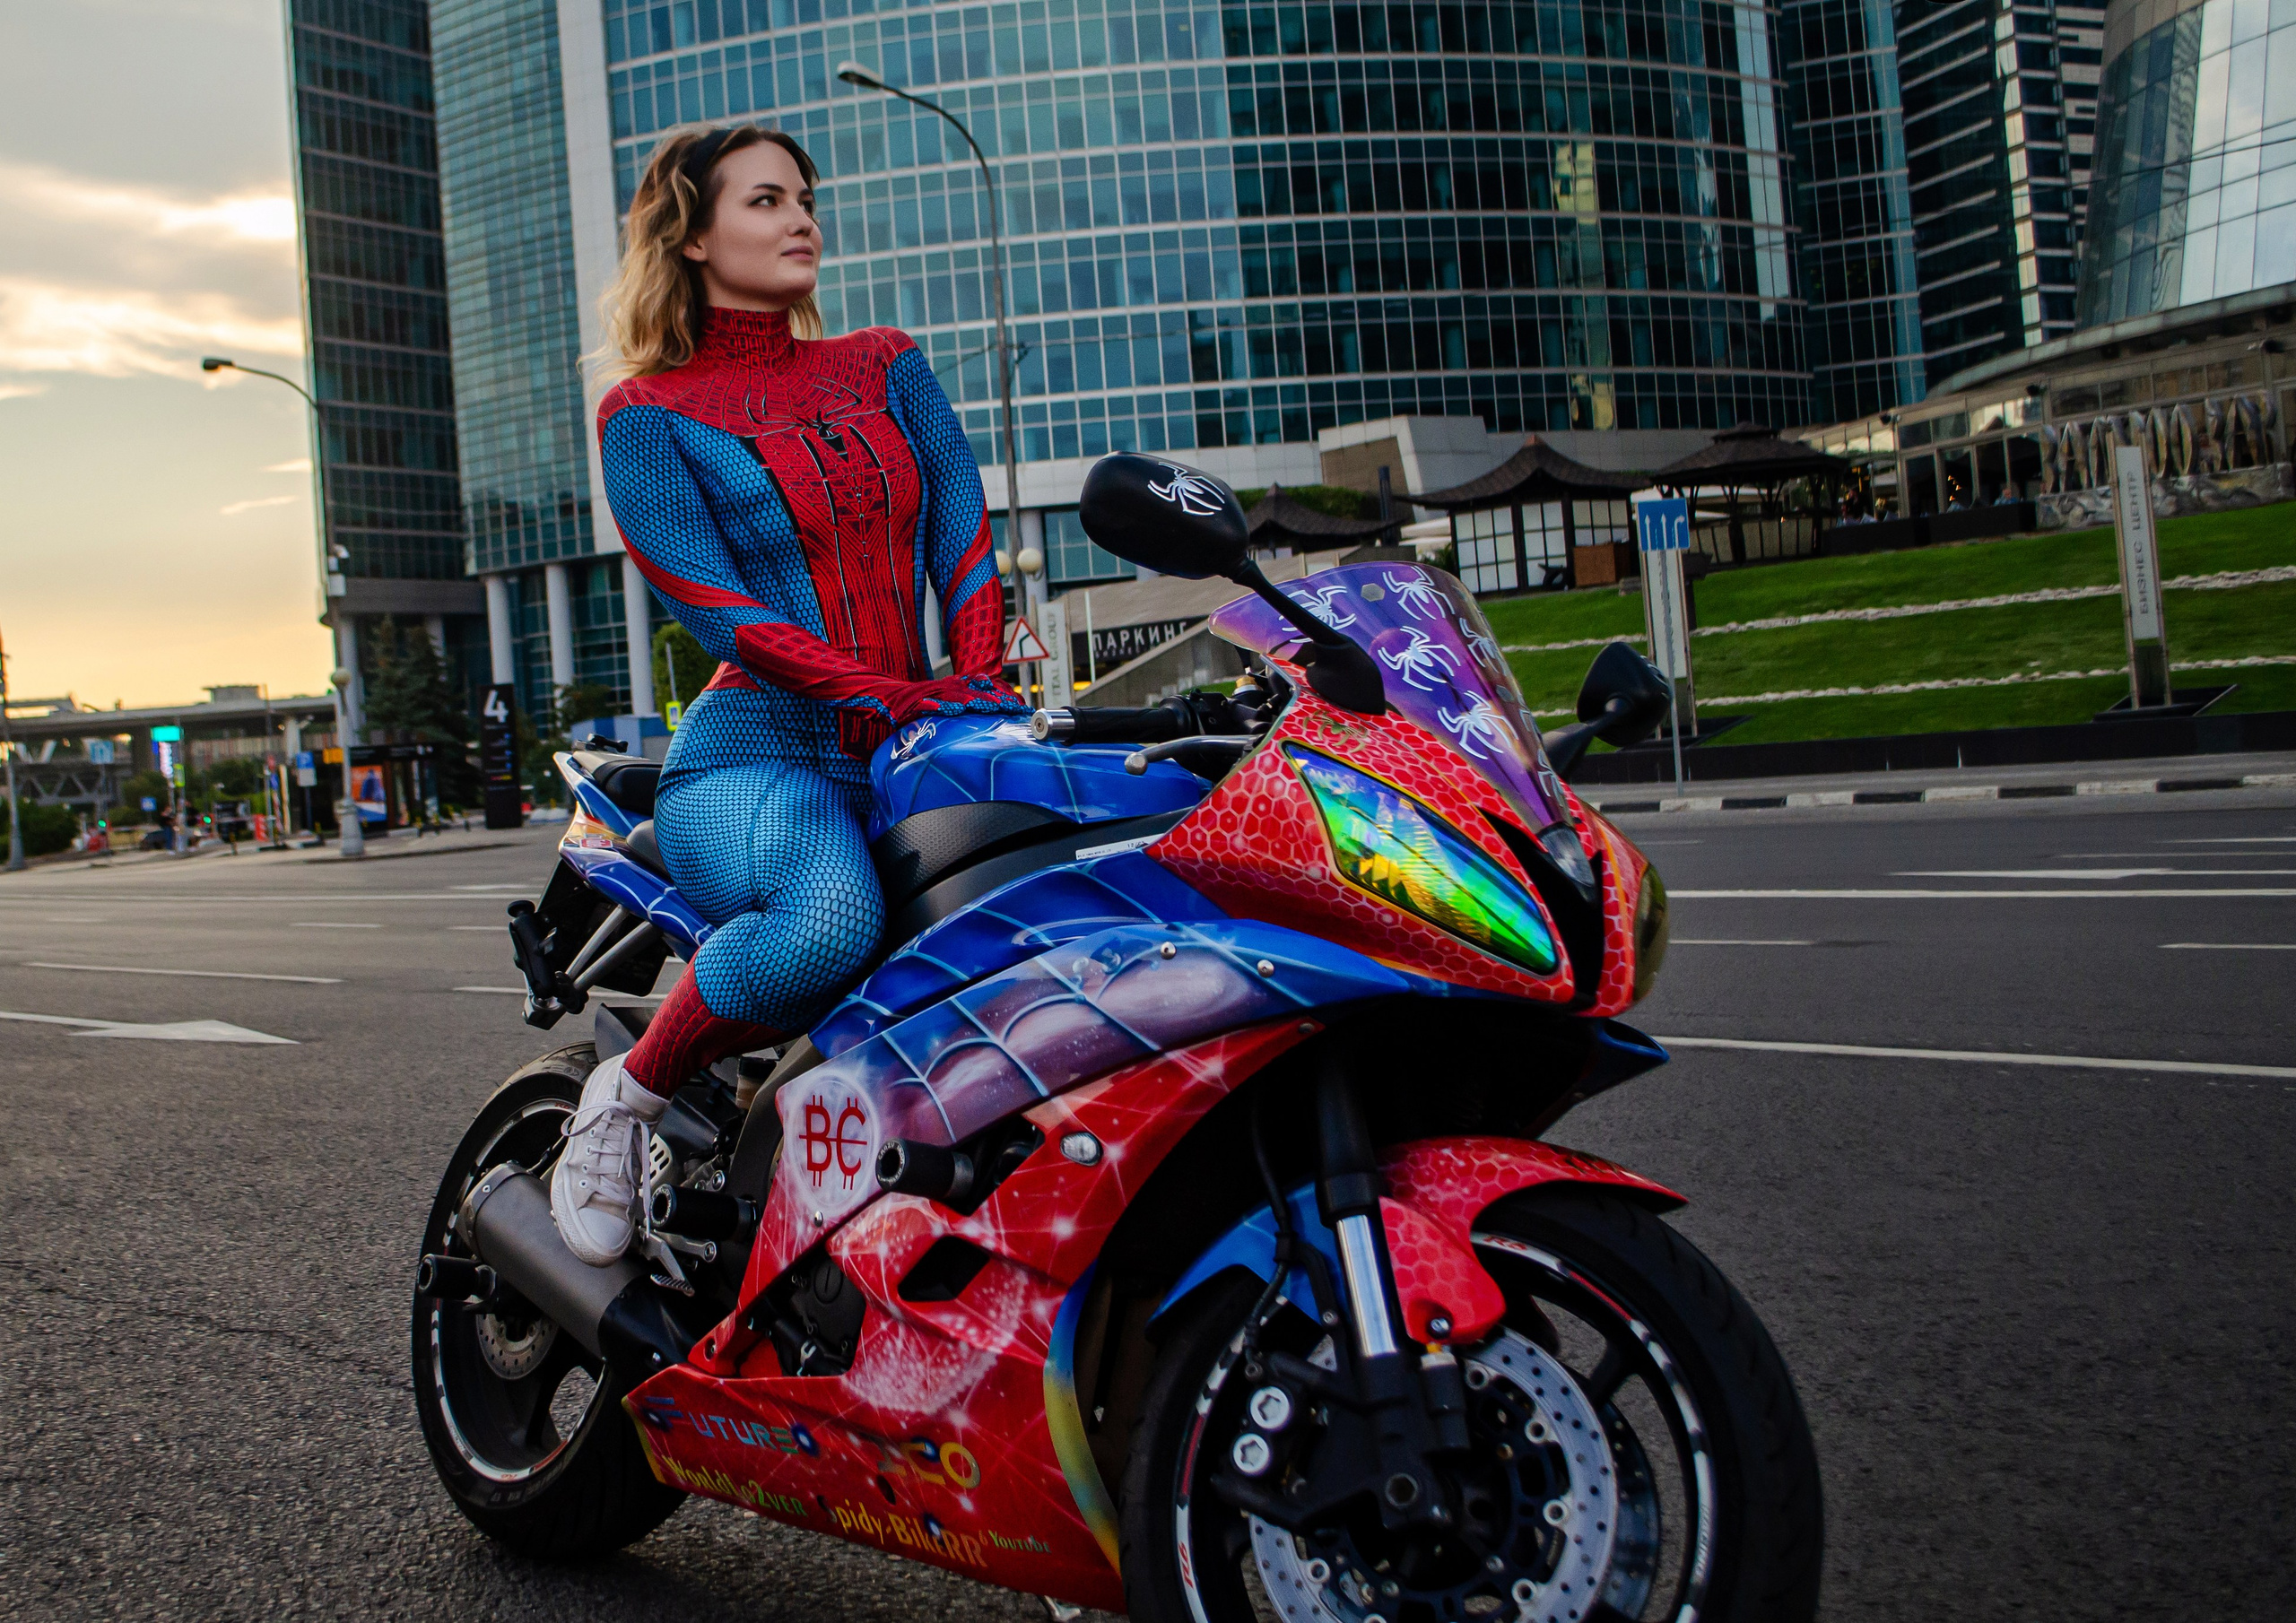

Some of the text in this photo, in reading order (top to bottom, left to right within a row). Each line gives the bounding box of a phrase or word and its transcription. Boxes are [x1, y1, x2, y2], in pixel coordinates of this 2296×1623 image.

[2127, 471, 2149, 615] БИЗНЕС ЦЕНТР
[1092, 621, 1187, 651] ПАРКИНГ
[483, 690, 509, 723] 4
[1483, 1234, 1527, 1252] R6
